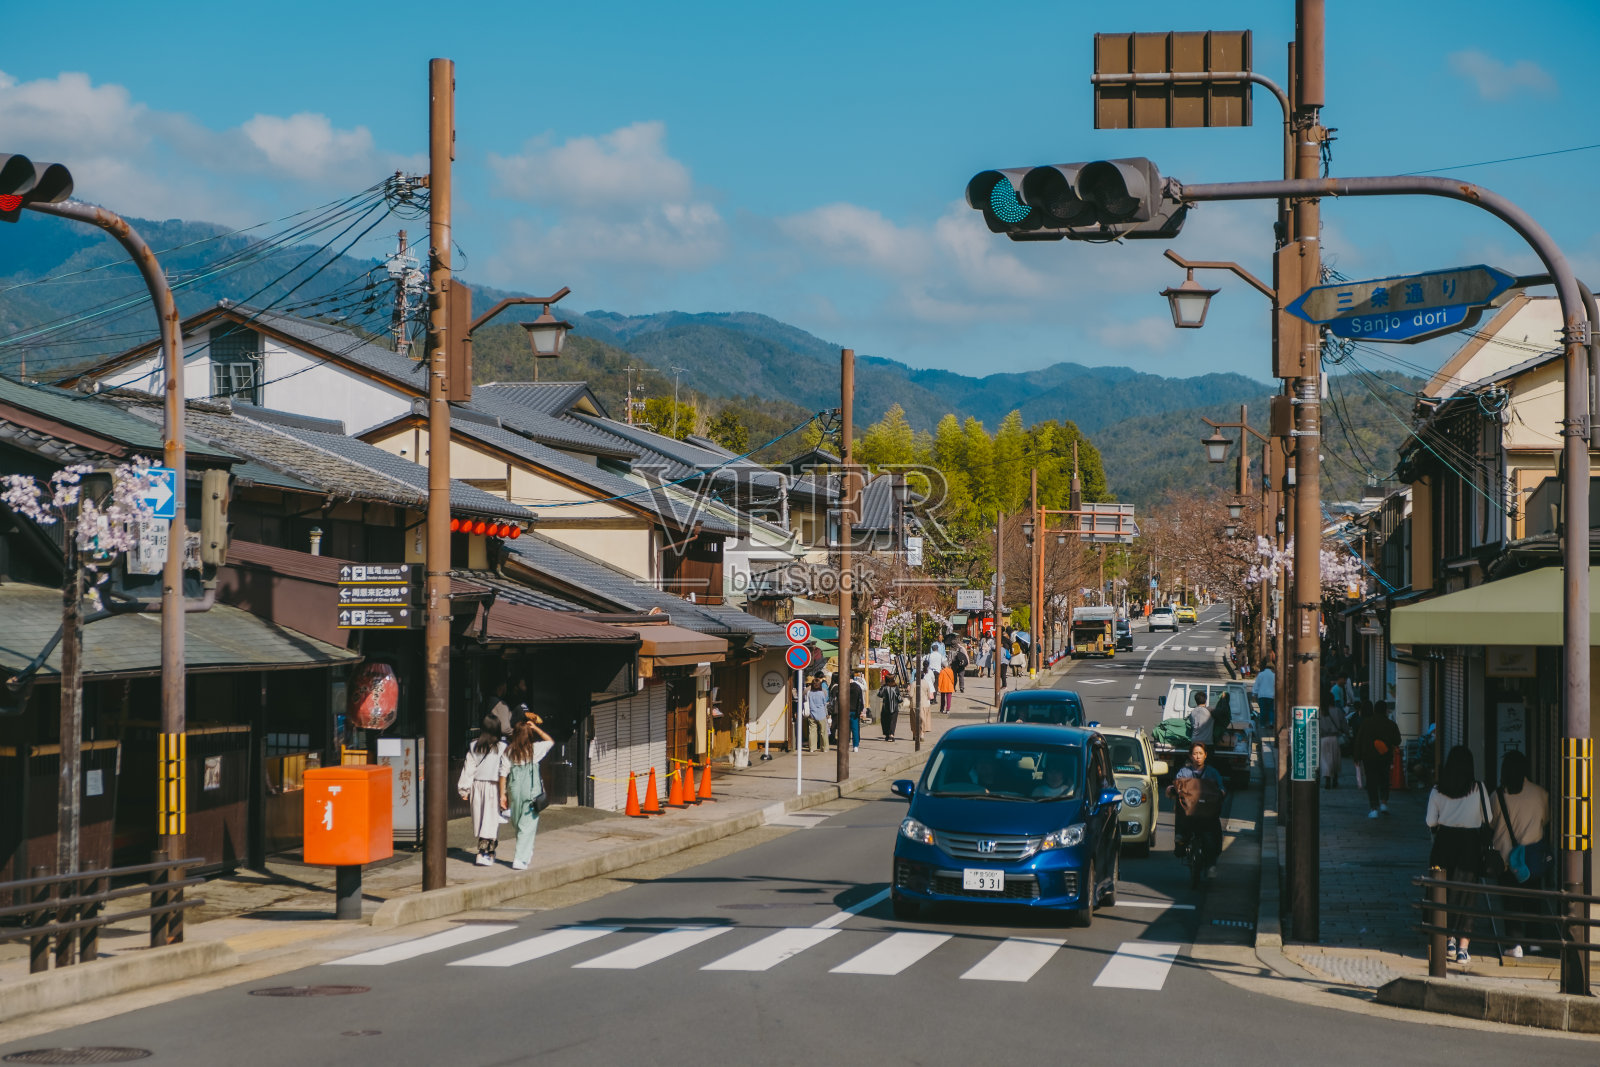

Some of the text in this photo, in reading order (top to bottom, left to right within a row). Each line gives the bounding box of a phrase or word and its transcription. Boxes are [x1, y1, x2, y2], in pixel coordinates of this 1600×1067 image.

[1336, 278, 1457, 313] 三条通り
[1351, 308, 1447, 333] Sanjo dori
[791, 625, 807, 637] 30
